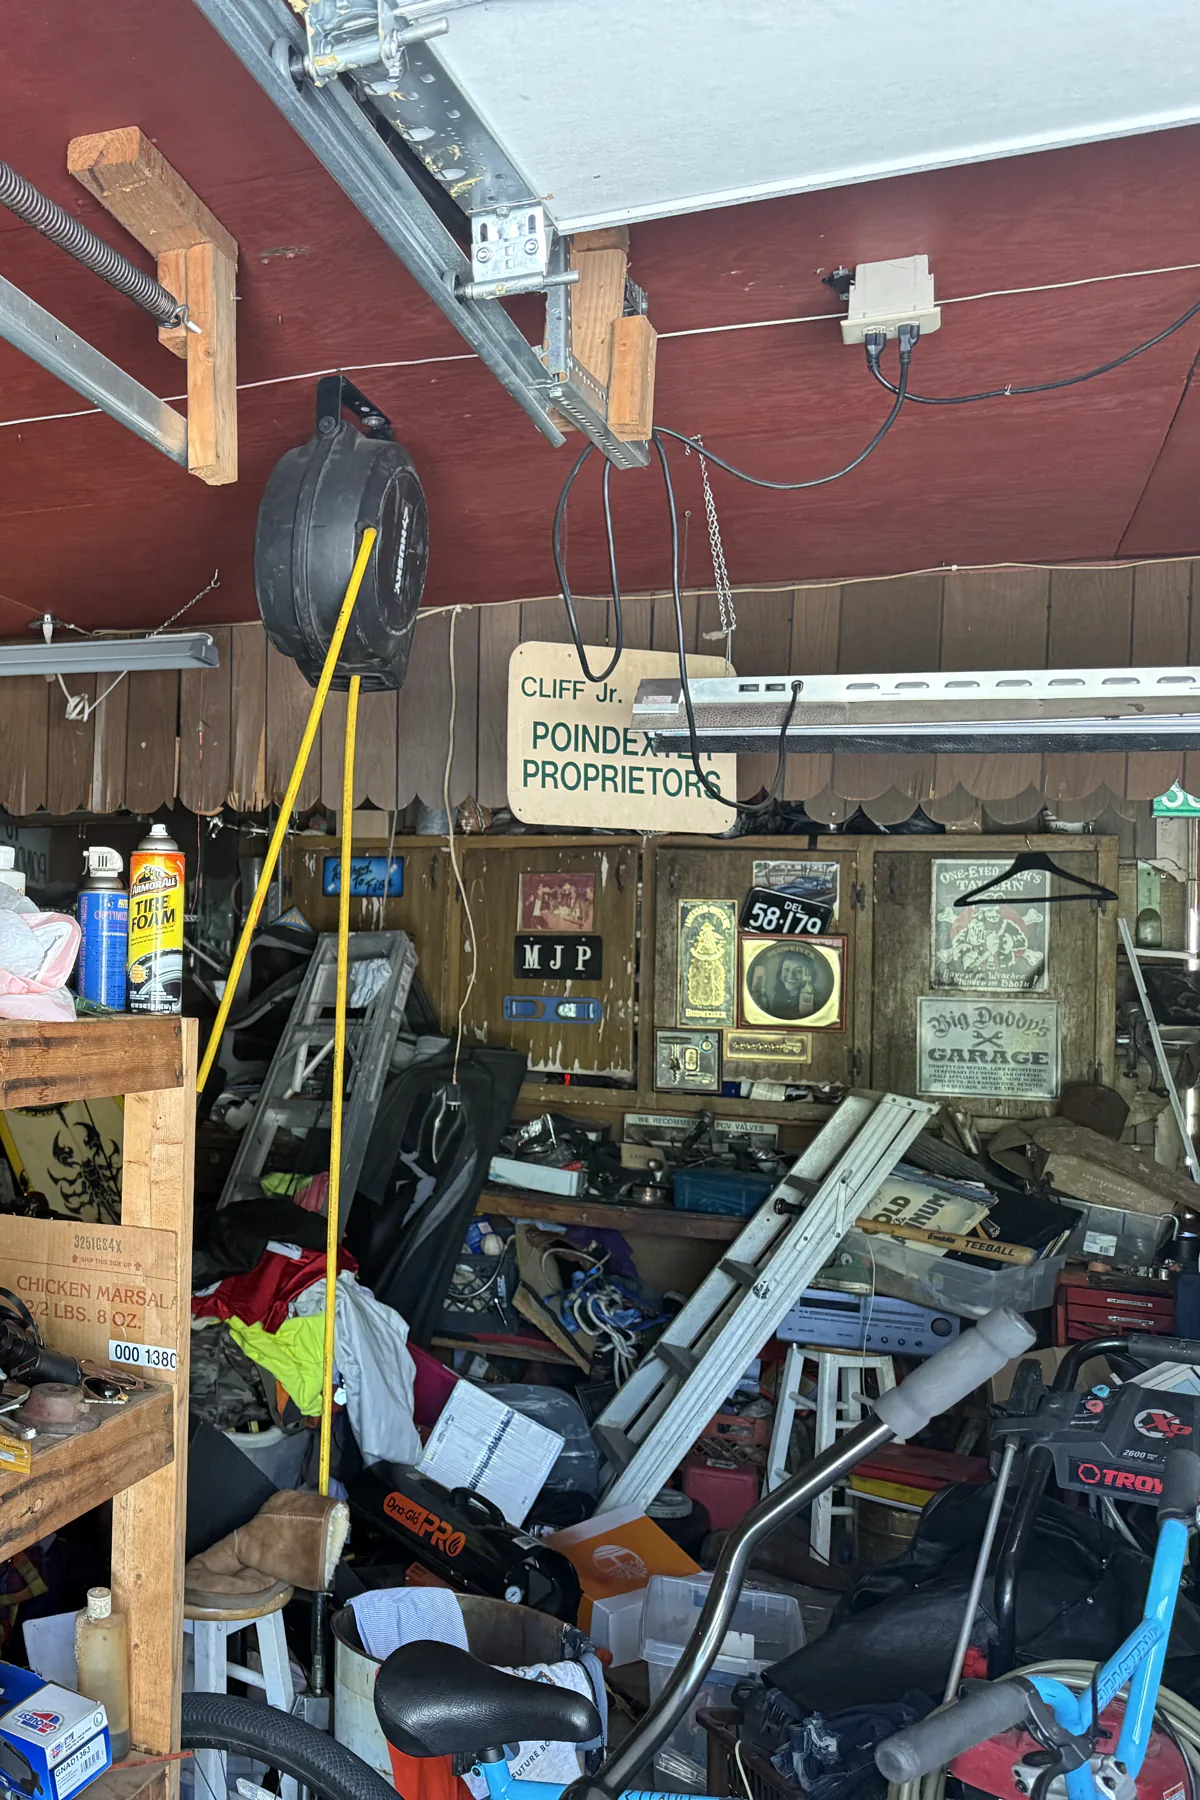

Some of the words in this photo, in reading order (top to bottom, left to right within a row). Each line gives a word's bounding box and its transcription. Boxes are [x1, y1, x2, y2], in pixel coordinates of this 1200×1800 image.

[520, 676, 586, 701] CLIFF
[595, 682, 623, 704] Jr.
[522, 759, 722, 799] PROPRIETORS
[940, 865, 999, 884] ONE-EYED
[956, 880, 1024, 892] TAERN
[135, 895, 170, 916] TIRE
[131, 909, 176, 933] FOAM
[523, 944, 541, 969] M
[550, 945, 562, 971] J
[575, 946, 591, 971] P
[927, 1010, 970, 1038] Big
[928, 1048, 1049, 1066] GARAGE
[653, 1117, 699, 1127] RECOMMEN
[715, 1121, 732, 1129] PCV
[735, 1123, 764, 1132] VALVES
[964, 1240, 1015, 1257] TEEBALL
[16, 1275, 91, 1299] CHICKEN
[96, 1285, 177, 1310] MARSALA
[54, 1305, 91, 1323] LBS.
[97, 1310, 107, 1324] 8
[112, 1312, 142, 1329] OZ.
[114, 1344, 140, 1363] 000
[1122, 1449, 1147, 1459] 2600
[418, 1512, 466, 1557] PRO
[511, 1752, 541, 1779] FUTURE
